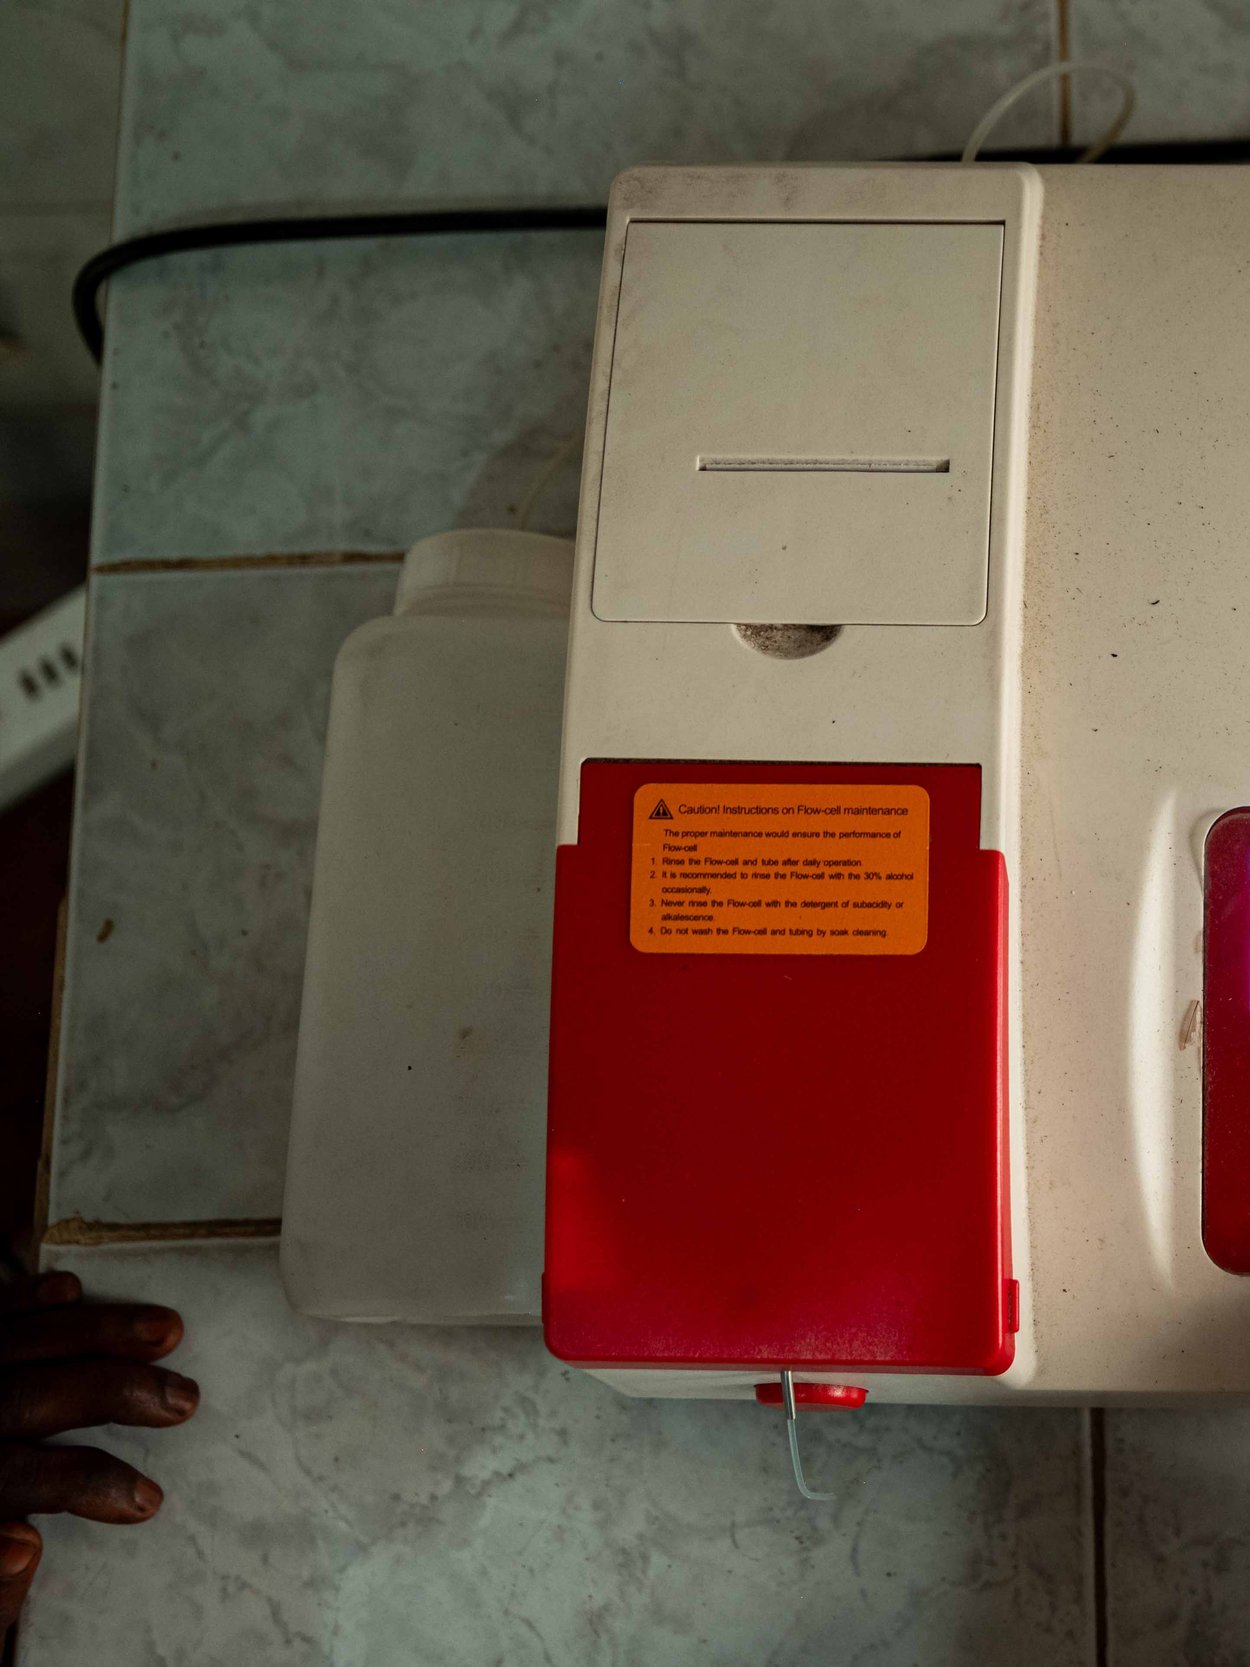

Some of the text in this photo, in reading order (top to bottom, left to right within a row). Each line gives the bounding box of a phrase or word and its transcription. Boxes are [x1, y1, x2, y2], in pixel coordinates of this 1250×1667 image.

[678, 804, 720, 815] Caution!
[723, 805, 779, 815] Instructions
[797, 804, 841, 816] Flow-cell
[844, 806, 908, 816] maintenance
[664, 829, 680, 837] The
[681, 831, 709, 839] proper
[710, 829, 763, 838] maintenance
[765, 830, 789, 838] would
[822, 830, 836, 840] the
[839, 830, 891, 840] performance
[663, 843, 698, 852] Flow-cell
[662, 857, 685, 866] Rinse
[688, 857, 701, 866] the
[704, 857, 739, 866] Flow-cell
[742, 858, 758, 866] and
[761, 858, 779, 866] tube
[782, 858, 800, 867] after
[802, 858, 821, 869] daily
[679, 871, 737, 880] recommended
[751, 871, 771, 880] rinse
[774, 871, 787, 880] the
[790, 871, 825, 880] Flow-cell
[828, 872, 845, 880] with
[848, 872, 861, 880] the
[864, 872, 882, 880] 30%
[885, 872, 914, 881] alcohol
[661, 898, 685, 907] Never
[688, 899, 708, 908] rinse
[711, 899, 724, 908] the
[727, 899, 762, 908] Flow-cell
[765, 899, 781, 908] with
[784, 900, 797, 908] the
[800, 900, 838, 910] detergent
[852, 900, 892, 910] subacidity
[676, 927, 689, 935] not
[691, 927, 713, 936] wash
[716, 927, 729, 936] the
[732, 927, 767, 936] Flow-cell
[770, 928, 786, 936] and
[789, 928, 813, 938] tubing
[830, 928, 849, 936] soak
